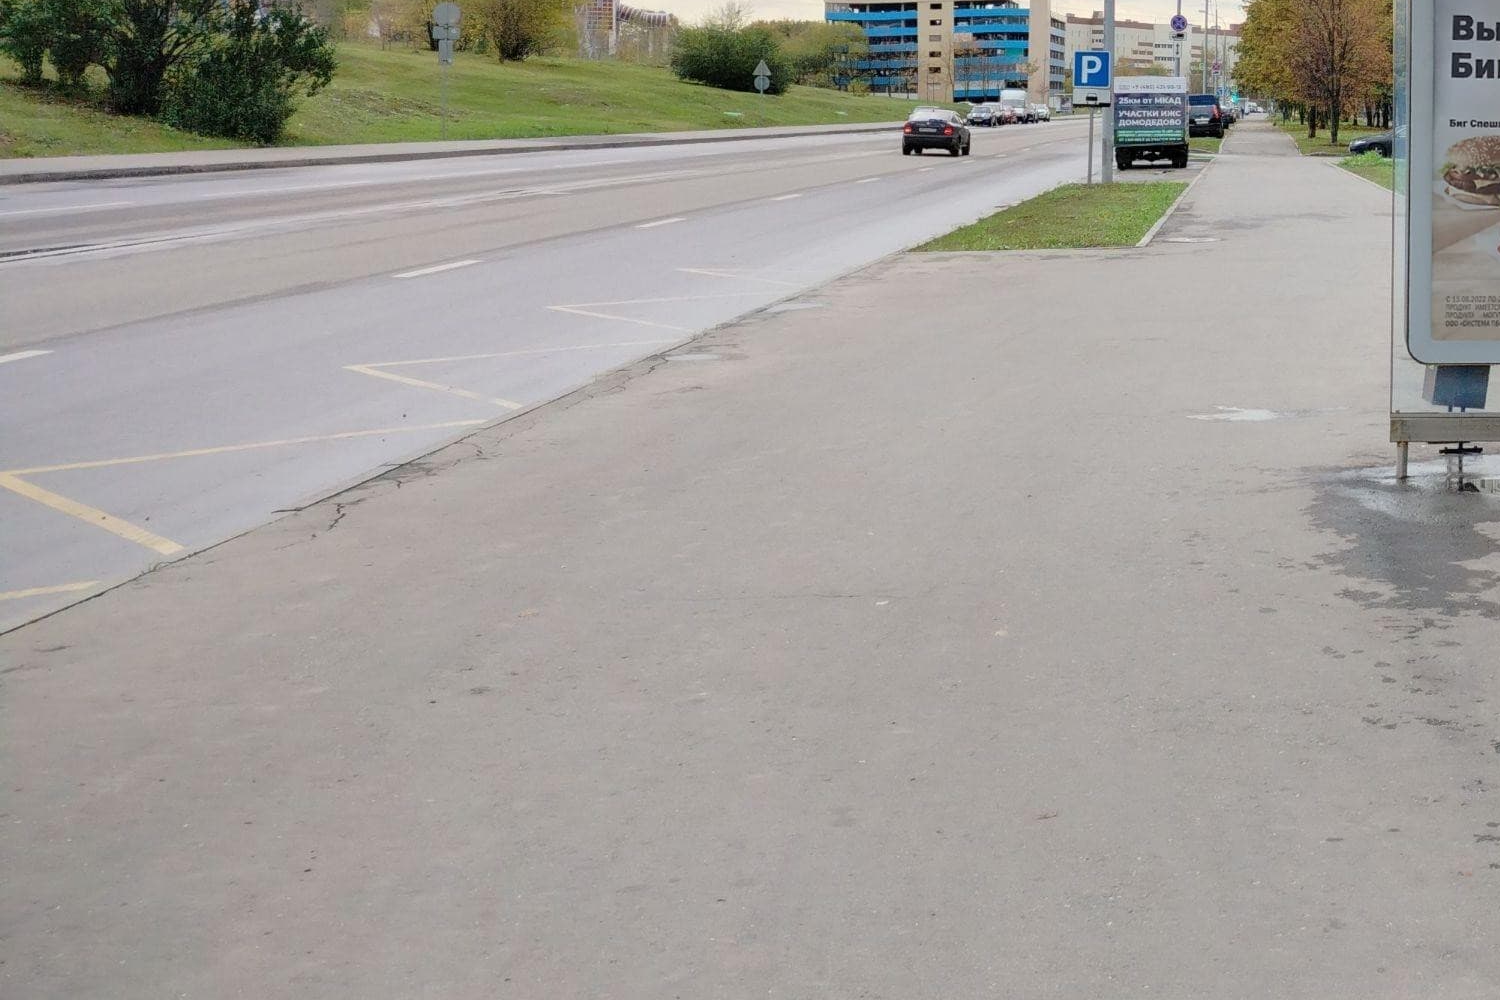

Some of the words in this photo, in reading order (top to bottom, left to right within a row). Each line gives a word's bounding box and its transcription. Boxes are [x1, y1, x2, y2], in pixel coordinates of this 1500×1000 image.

[1118, 96, 1140, 104] 25км
[1154, 96, 1181, 105] МКАД
[1118, 119, 1182, 127] ДОМОДЕДОВО
[1449, 118, 1468, 128] Биг
